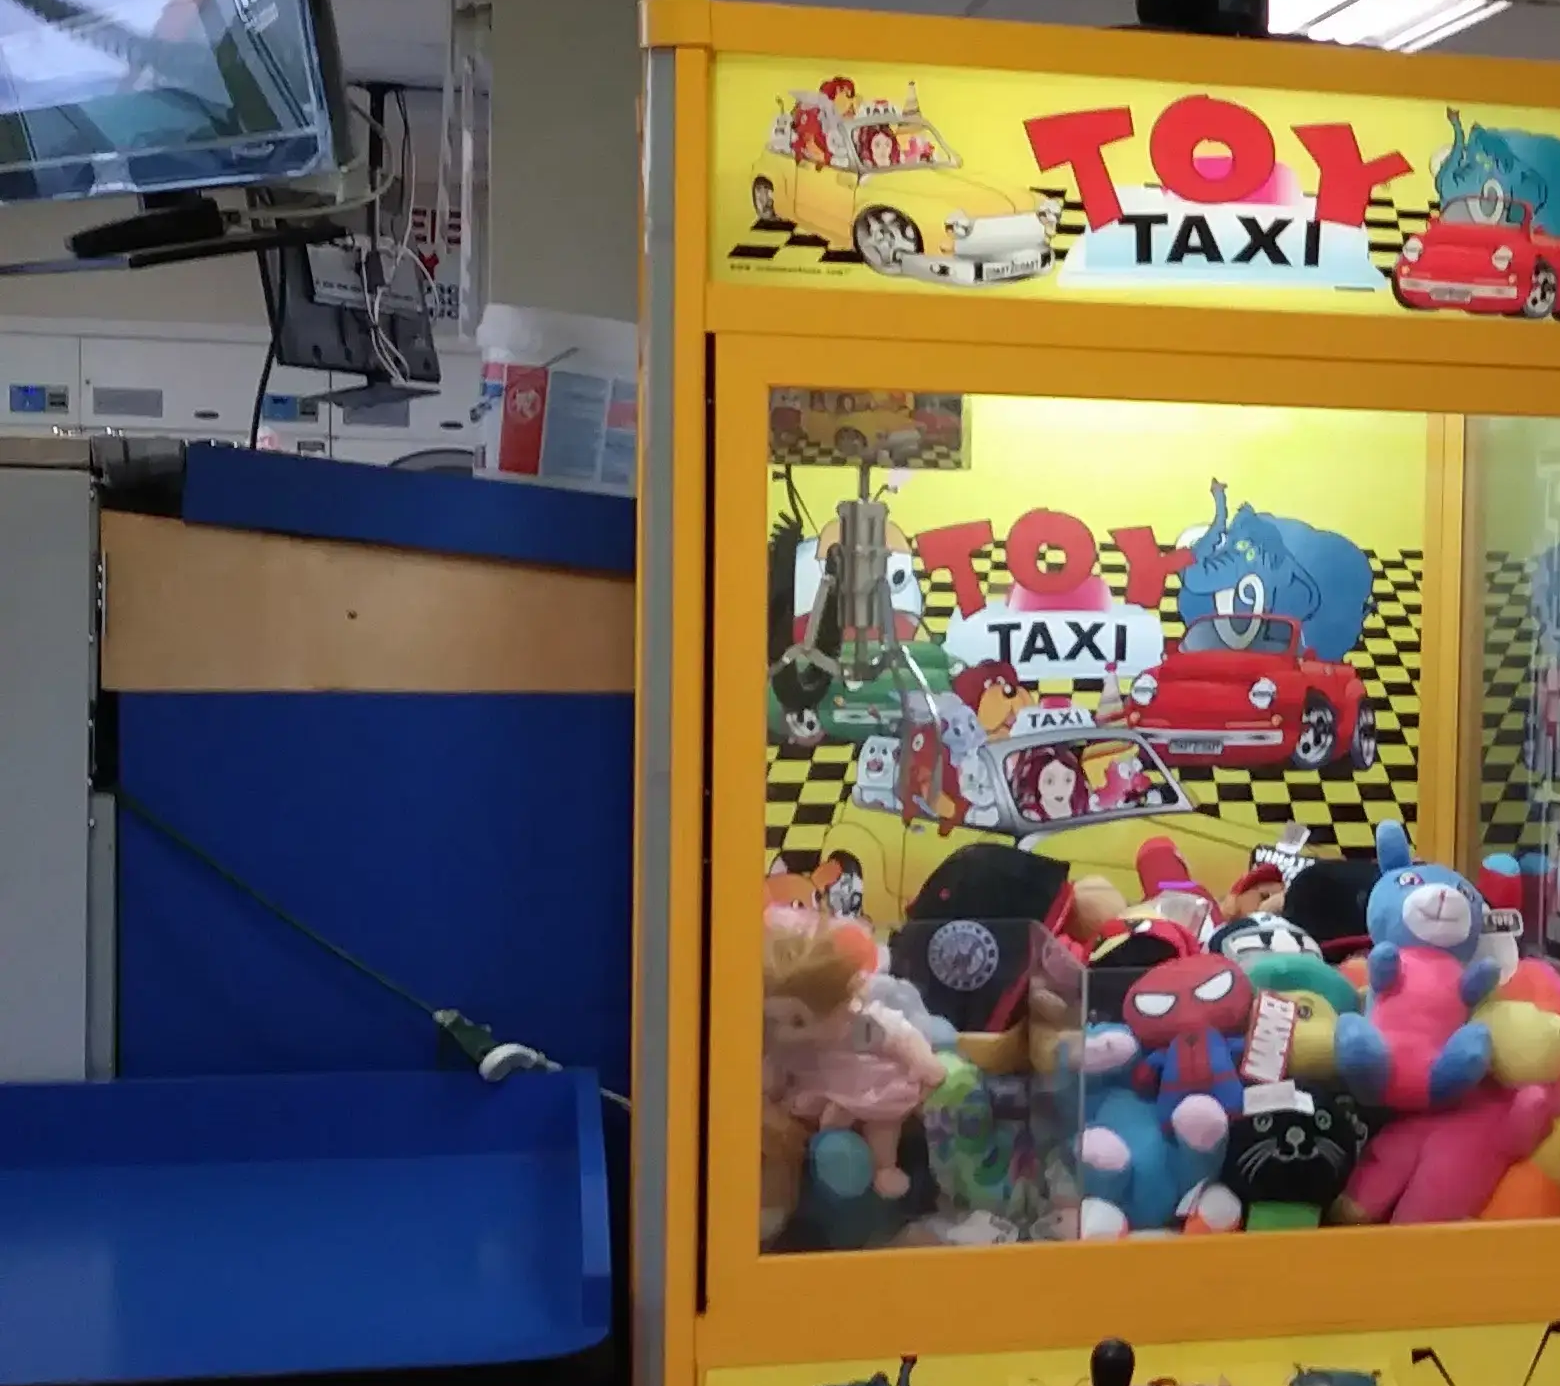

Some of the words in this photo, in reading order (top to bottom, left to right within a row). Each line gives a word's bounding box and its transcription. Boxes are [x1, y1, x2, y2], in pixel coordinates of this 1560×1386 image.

[1023, 94, 1415, 232] TOY
[1119, 213, 1321, 267] TAXI
[915, 507, 1197, 621] TOY
[987, 621, 1128, 664] TAXI
[1027, 711, 1084, 729] TAXI
